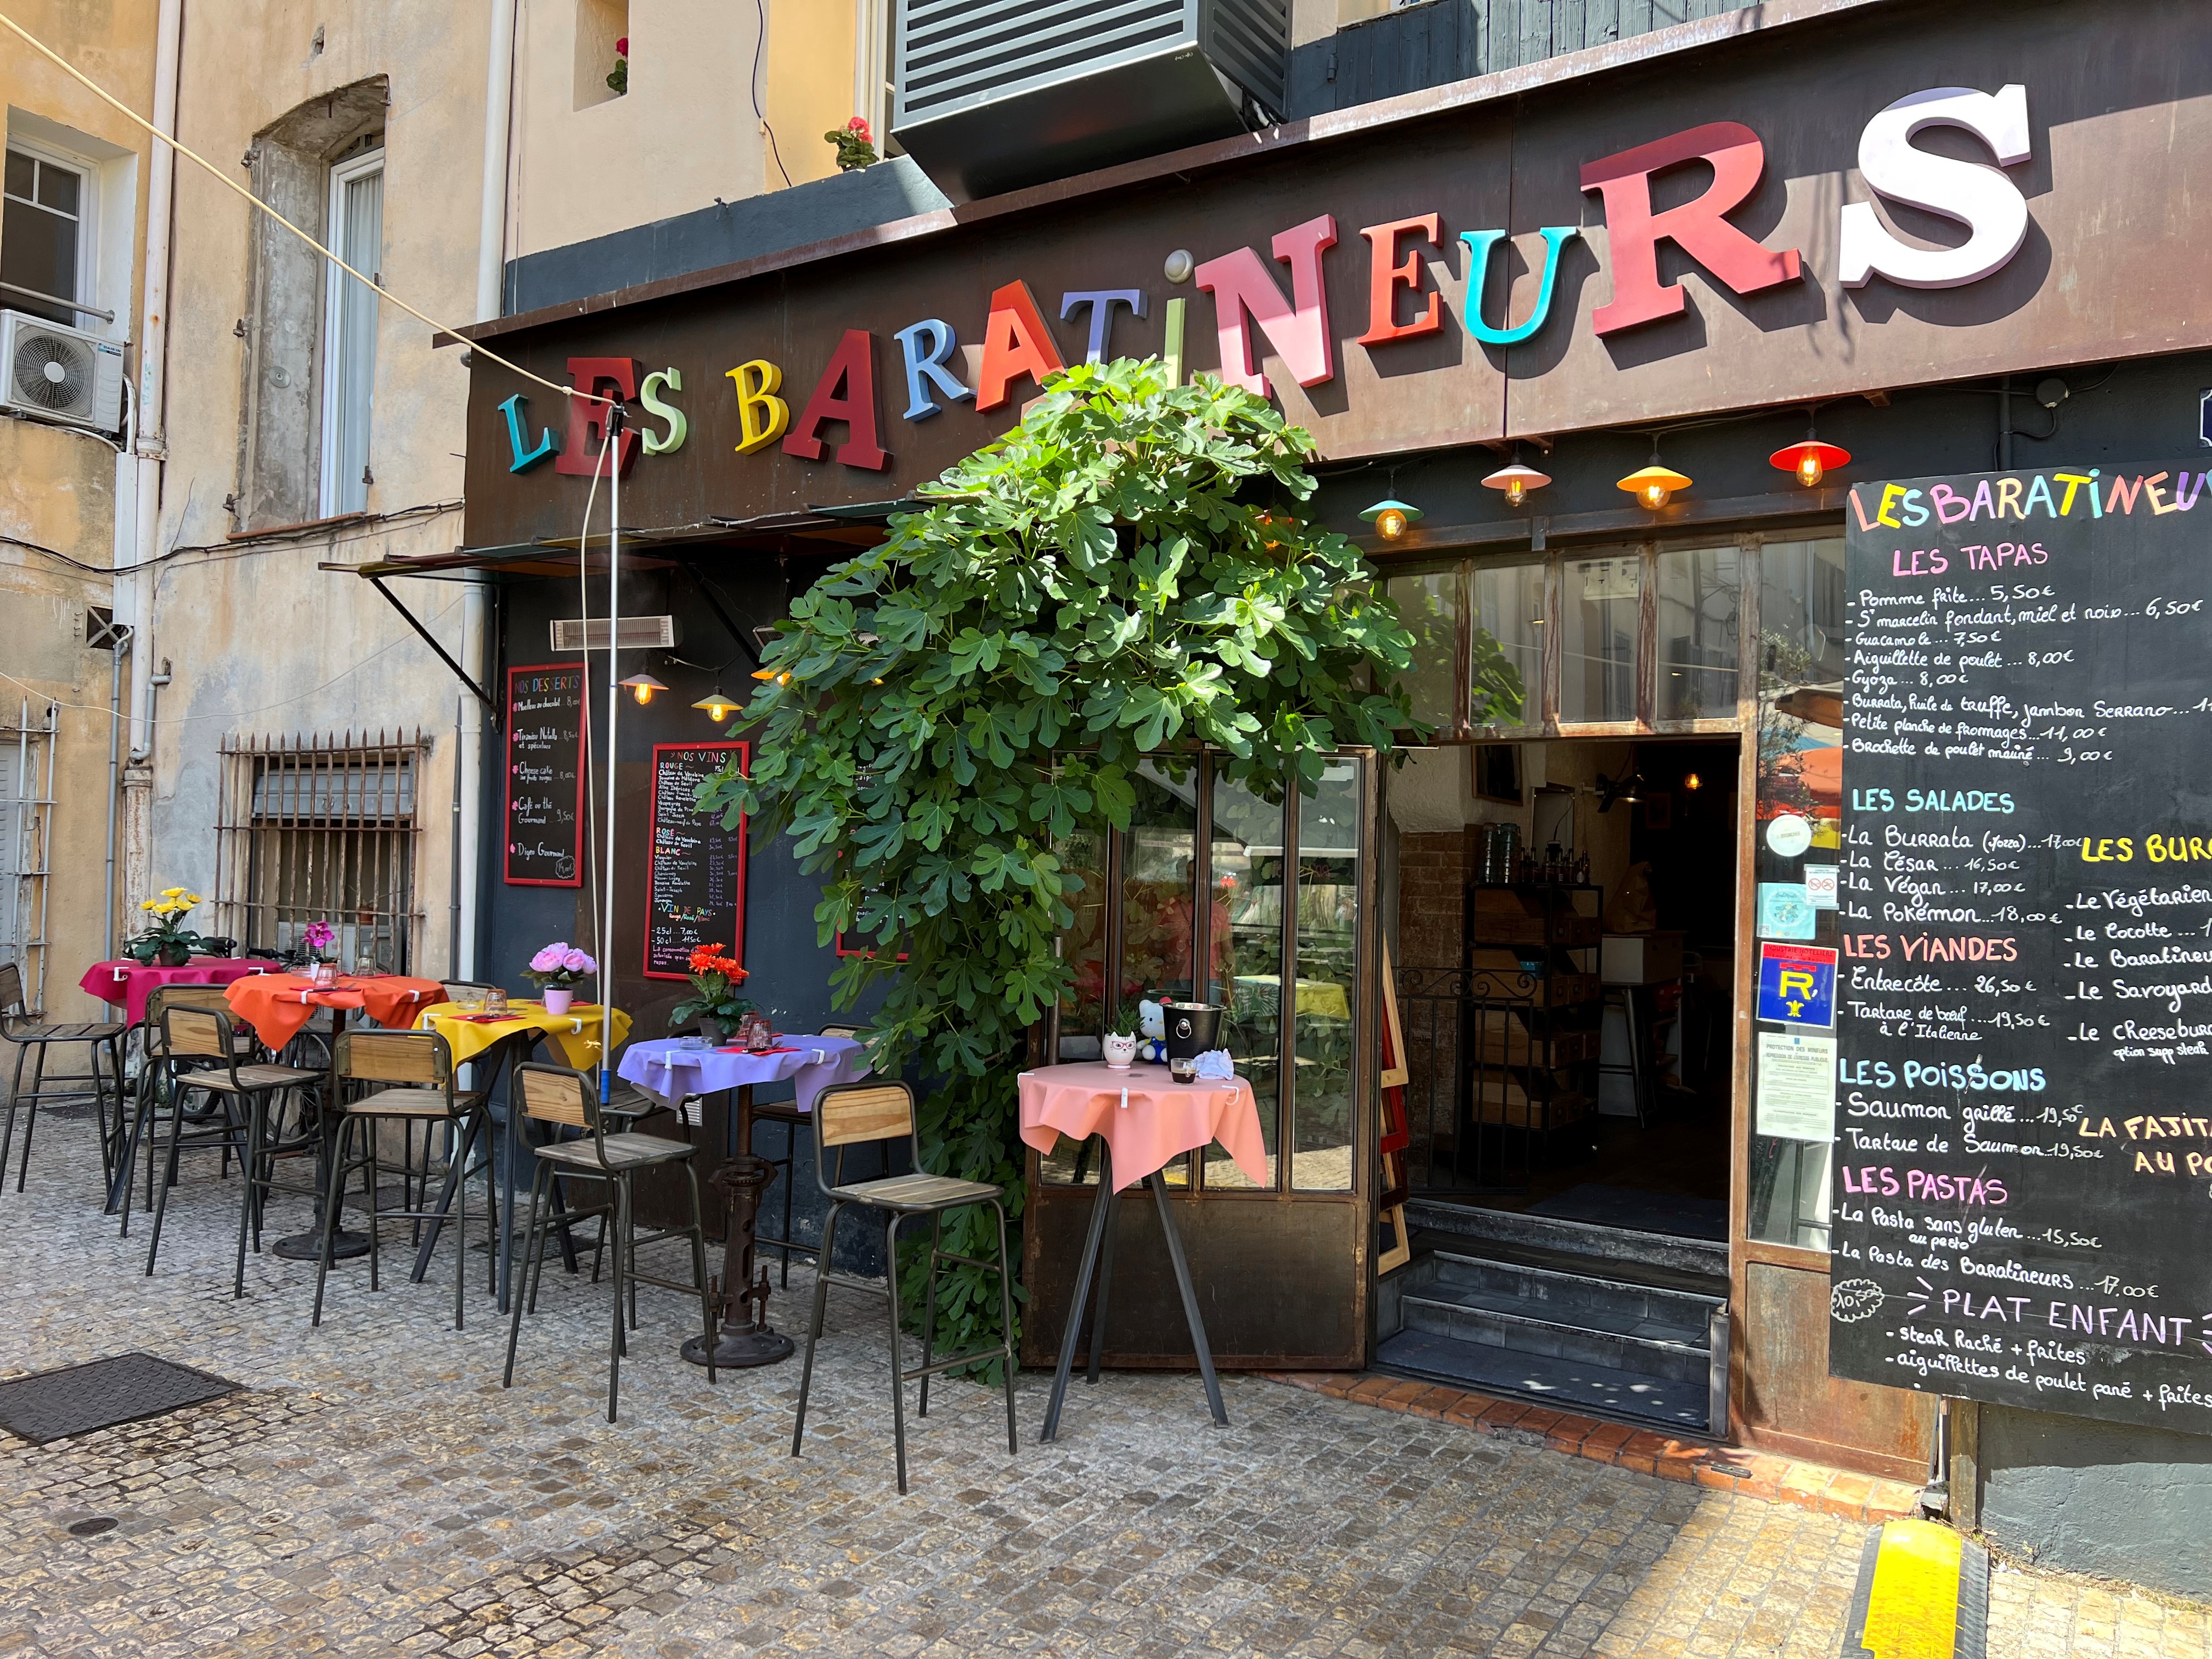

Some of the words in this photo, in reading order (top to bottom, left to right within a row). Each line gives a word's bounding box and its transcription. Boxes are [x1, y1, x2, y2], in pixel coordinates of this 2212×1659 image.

[497, 358, 687, 475] LES
[1893, 549, 1948, 576] LES
[1960, 543, 2047, 570] TAPAS
[1859, 590, 1925, 606] Pomme
[1990, 585, 2055, 602] 5,50€
[1877, 611, 1938, 628] marcelin
[2018, 604, 2057, 623] miel
[2062, 603, 2076, 622] et
[2146, 597, 2203, 619] 6,50€
[1855, 631, 1931, 646] Guacamole
[1852, 650, 1928, 678] Aiguillette
[1934, 652, 1951, 665] de
[1959, 651, 2002, 673] poulet
[2028, 650, 2074, 667] 8,00€
[515, 680, 529, 694] NOS
[533, 675, 580, 692] DESSERTS
[1852, 669, 1898, 695] Gyoza
[1920, 672, 1968, 687] 8,00€
[1909, 693, 1937, 711] huile
[1940, 699, 1953, 711] de
[2021, 701, 2085, 727] jambon
[1852, 712, 1888, 730] Petite
[1894, 718, 1935, 735] planche
[1938, 723, 1952, 733] de
[518, 741, 525, 749] et
[1852, 737, 1916, 755] Brochette
[1925, 741, 1940, 755] de
[1945, 741, 1985, 759] poulet
[660, 762, 684, 770] ROUGE
[677, 752, 695, 762] NOS
[698, 752, 726, 764] VINS
[518, 797, 533, 816] Café
[543, 797, 552, 809] thé
[1853, 788, 1894, 812] LES
[1905, 789, 2015, 814] SALADES
[1848, 825, 1873, 845] La
[1885, 825, 1973, 848] Burrata
[656, 846, 681, 856] BLANC
[1850, 850, 1872, 868] La
[1884, 850, 1938, 872] César
[2081, 837, 2133, 862] LES
[1849, 872, 1873, 891] La
[1884, 876, 1946, 907] Végan
[2076, 893, 2101, 909] Le
[2102, 884, 2212, 917] Végétarien
[661, 904, 679, 913] VIN
[684, 906, 692, 914] DE
[697, 907, 713, 917] PAYS
[1849, 901, 1872, 919] La
[2076, 926, 2096, 941] Le
[2105, 923, 2172, 939] Cocotte
[1843, 934, 1891, 959] LES
[2074, 952, 2098, 968] Le
[1779, 970, 1814, 1000] R
[1852, 966, 1943, 992] Entrecôte
[2079, 981, 2103, 1000] Le
[1847, 1001, 1913, 1020] Tartare
[1918, 1006, 1933, 1020] de
[1880, 1021, 1892, 1036] à
[2079, 1023, 2100, 1041] Le
[2113, 1046, 2145, 1062] option
[2147, 1048, 2175, 1065] supp
[2176, 1041, 2209, 1055] steak
[1841, 1058, 1896, 1088] LES
[1848, 1092, 1951, 1119] Saumon
[2079, 1118, 2117, 1138] LA
[1926, 1134, 1949, 1153] de
[2135, 1152, 2175, 1174] AU
[1843, 1166, 1900, 1195] LES
[1907, 1166, 2007, 1205] PASTAS
[1842, 1203, 1863, 1222] La
[1871, 1207, 1914, 1229] Pasta
[1924, 1217, 1962, 1234] sans
[1968, 1217, 2023, 1244] gluten
[1909, 1234, 1927, 1244] au
[1931, 1237, 1969, 1251] pesto
[1842, 1241, 1860, 1259] La
[1869, 1246, 1914, 1267] Pasta
[1921, 1254, 1949, 1271] des
[1960, 1256, 2073, 1289] Baratineurs
[1943, 1289, 2035, 1322] PLAT
[2045, 1301, 2192, 1347] ENFANT
[1900, 1326, 1949, 1347] steak
[2027, 1340, 2087, 1367] frites
[1897, 1350, 1999, 1378] aiguillettes
[2005, 1365, 2029, 1383] de
[2035, 1372, 2086, 1391] poulet
[2092, 1382, 2132, 1400] pané
